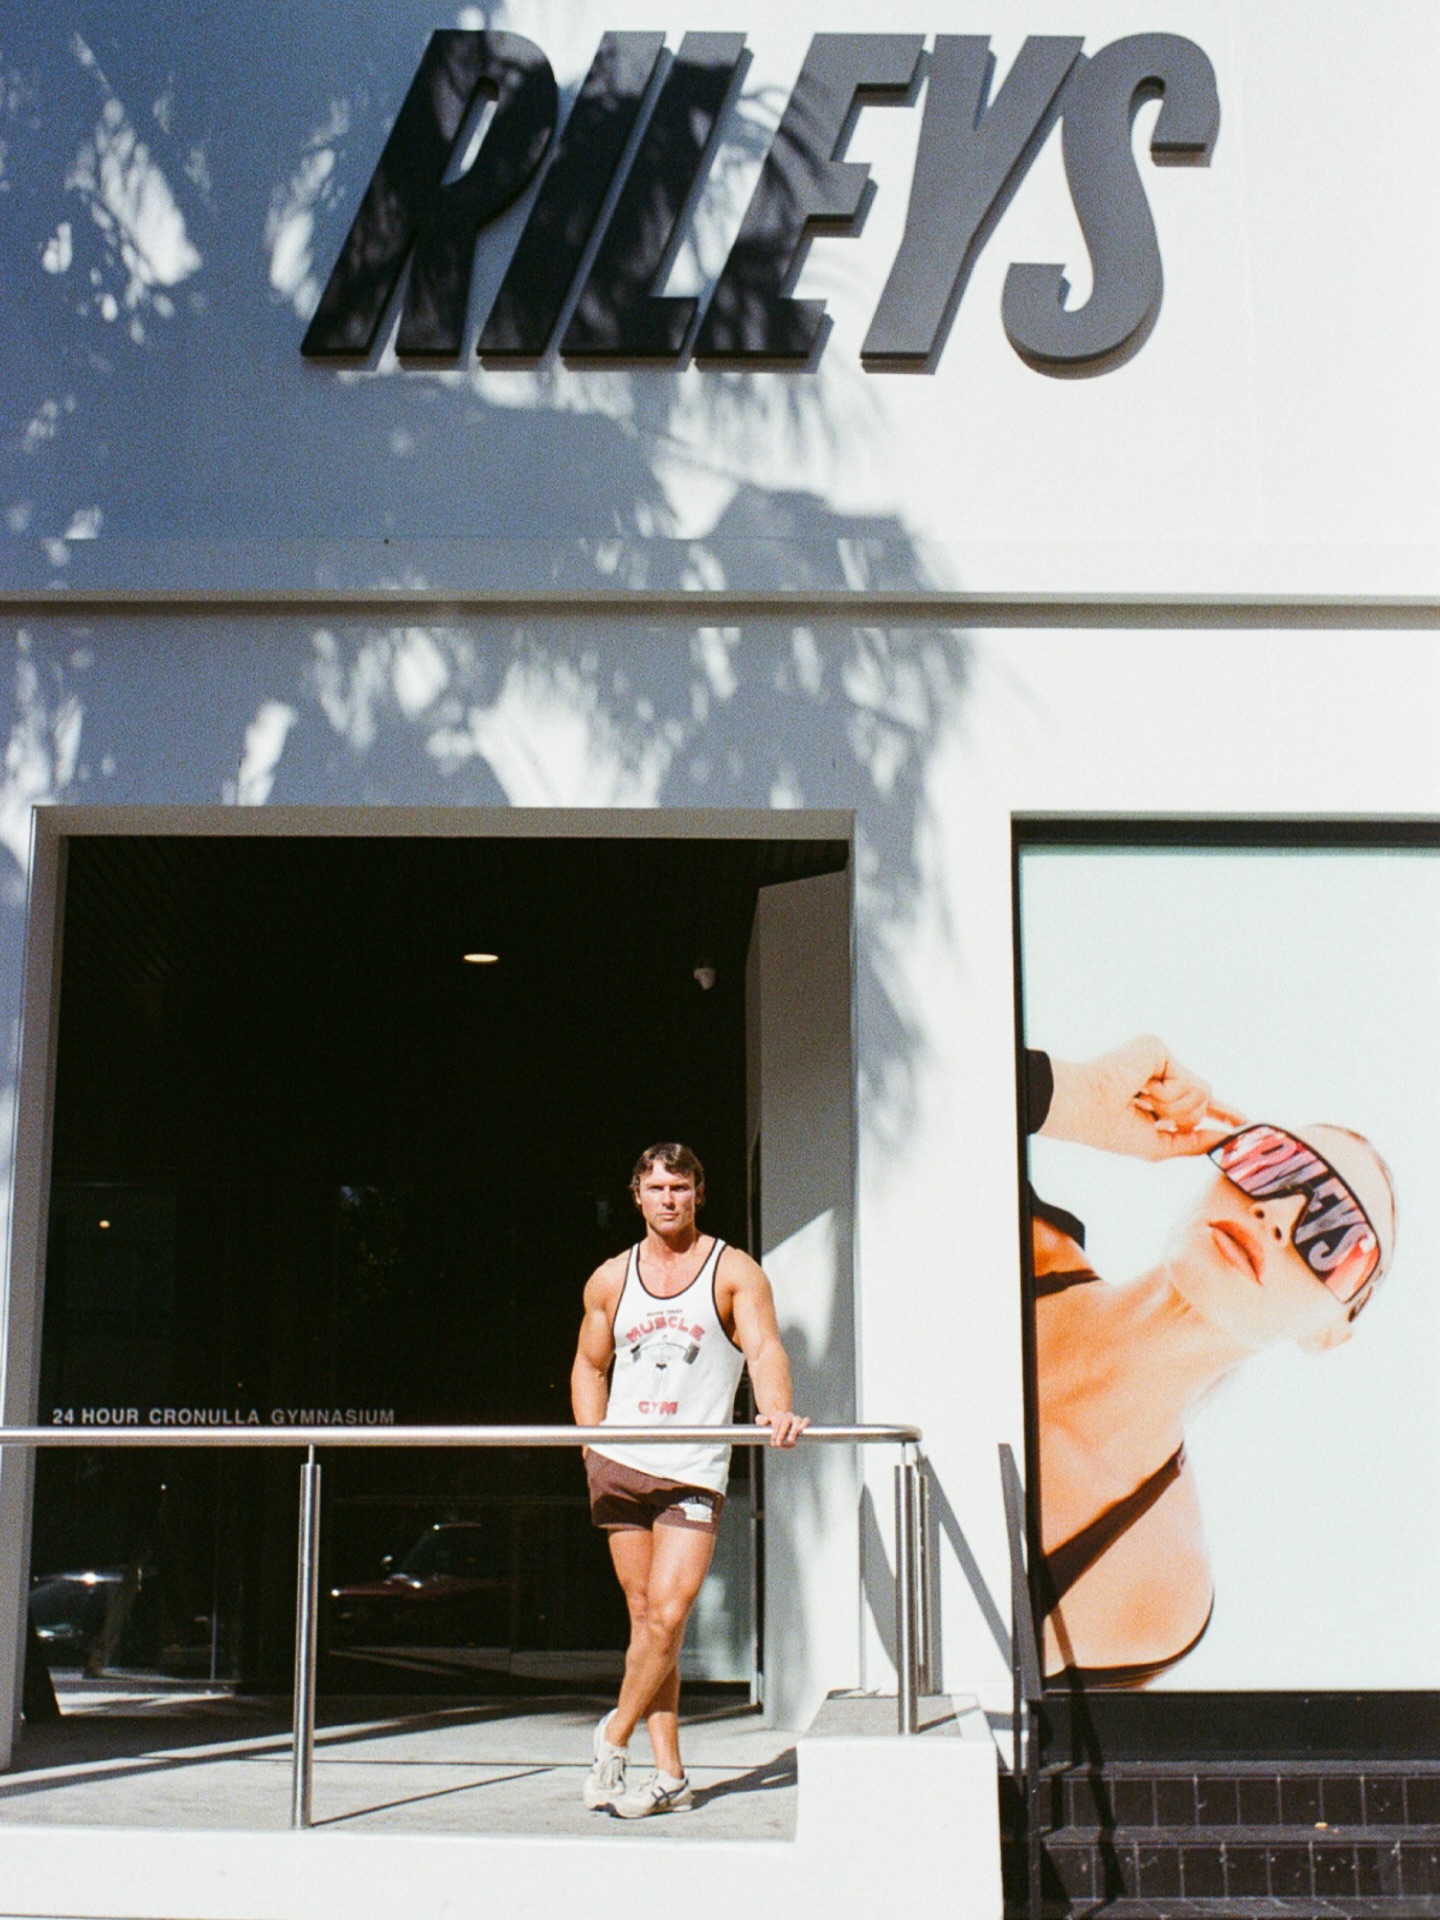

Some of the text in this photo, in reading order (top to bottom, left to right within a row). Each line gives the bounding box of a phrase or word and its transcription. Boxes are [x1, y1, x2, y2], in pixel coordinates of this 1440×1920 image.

[301, 29, 1220, 365] RILEYS
[626, 1316, 706, 1342] MUSCLE
[52, 1408, 395, 1425] 24 HOUR CRONULLA GYMNASIUM
[638, 1401, 678, 1415] GYM
